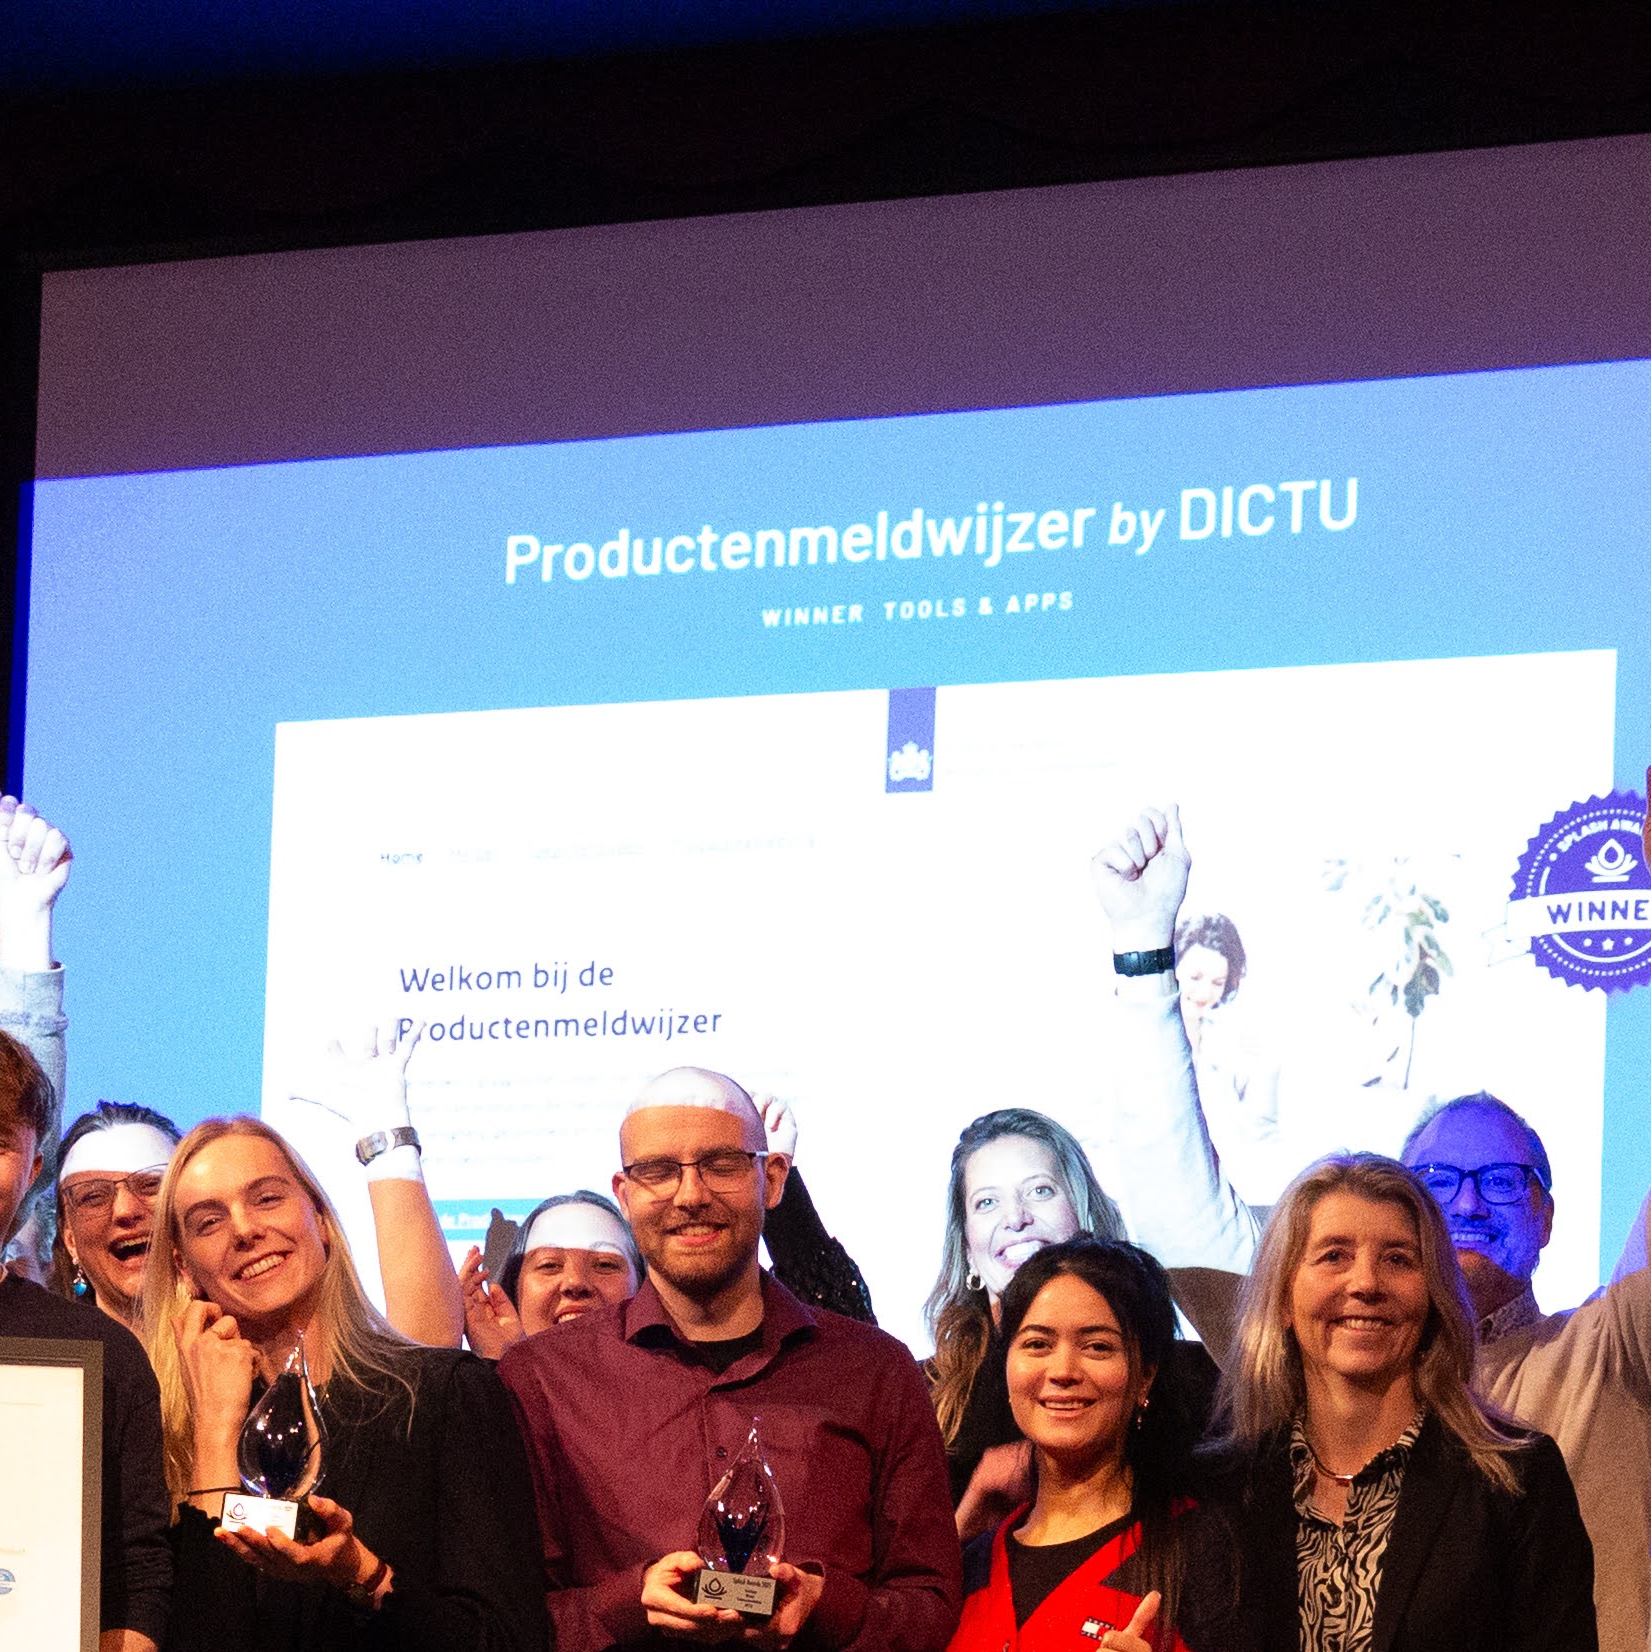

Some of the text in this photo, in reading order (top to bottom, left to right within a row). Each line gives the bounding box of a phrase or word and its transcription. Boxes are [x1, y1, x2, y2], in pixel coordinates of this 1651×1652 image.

[505, 477, 1358, 584] Productenmeldwijzer by DICTU
[762, 591, 1073, 627] WINNER TOOLS & APPS
[400, 960, 614, 994] Welkom bij de
[399, 1008, 722, 1042] Poductenmeldwijzer
